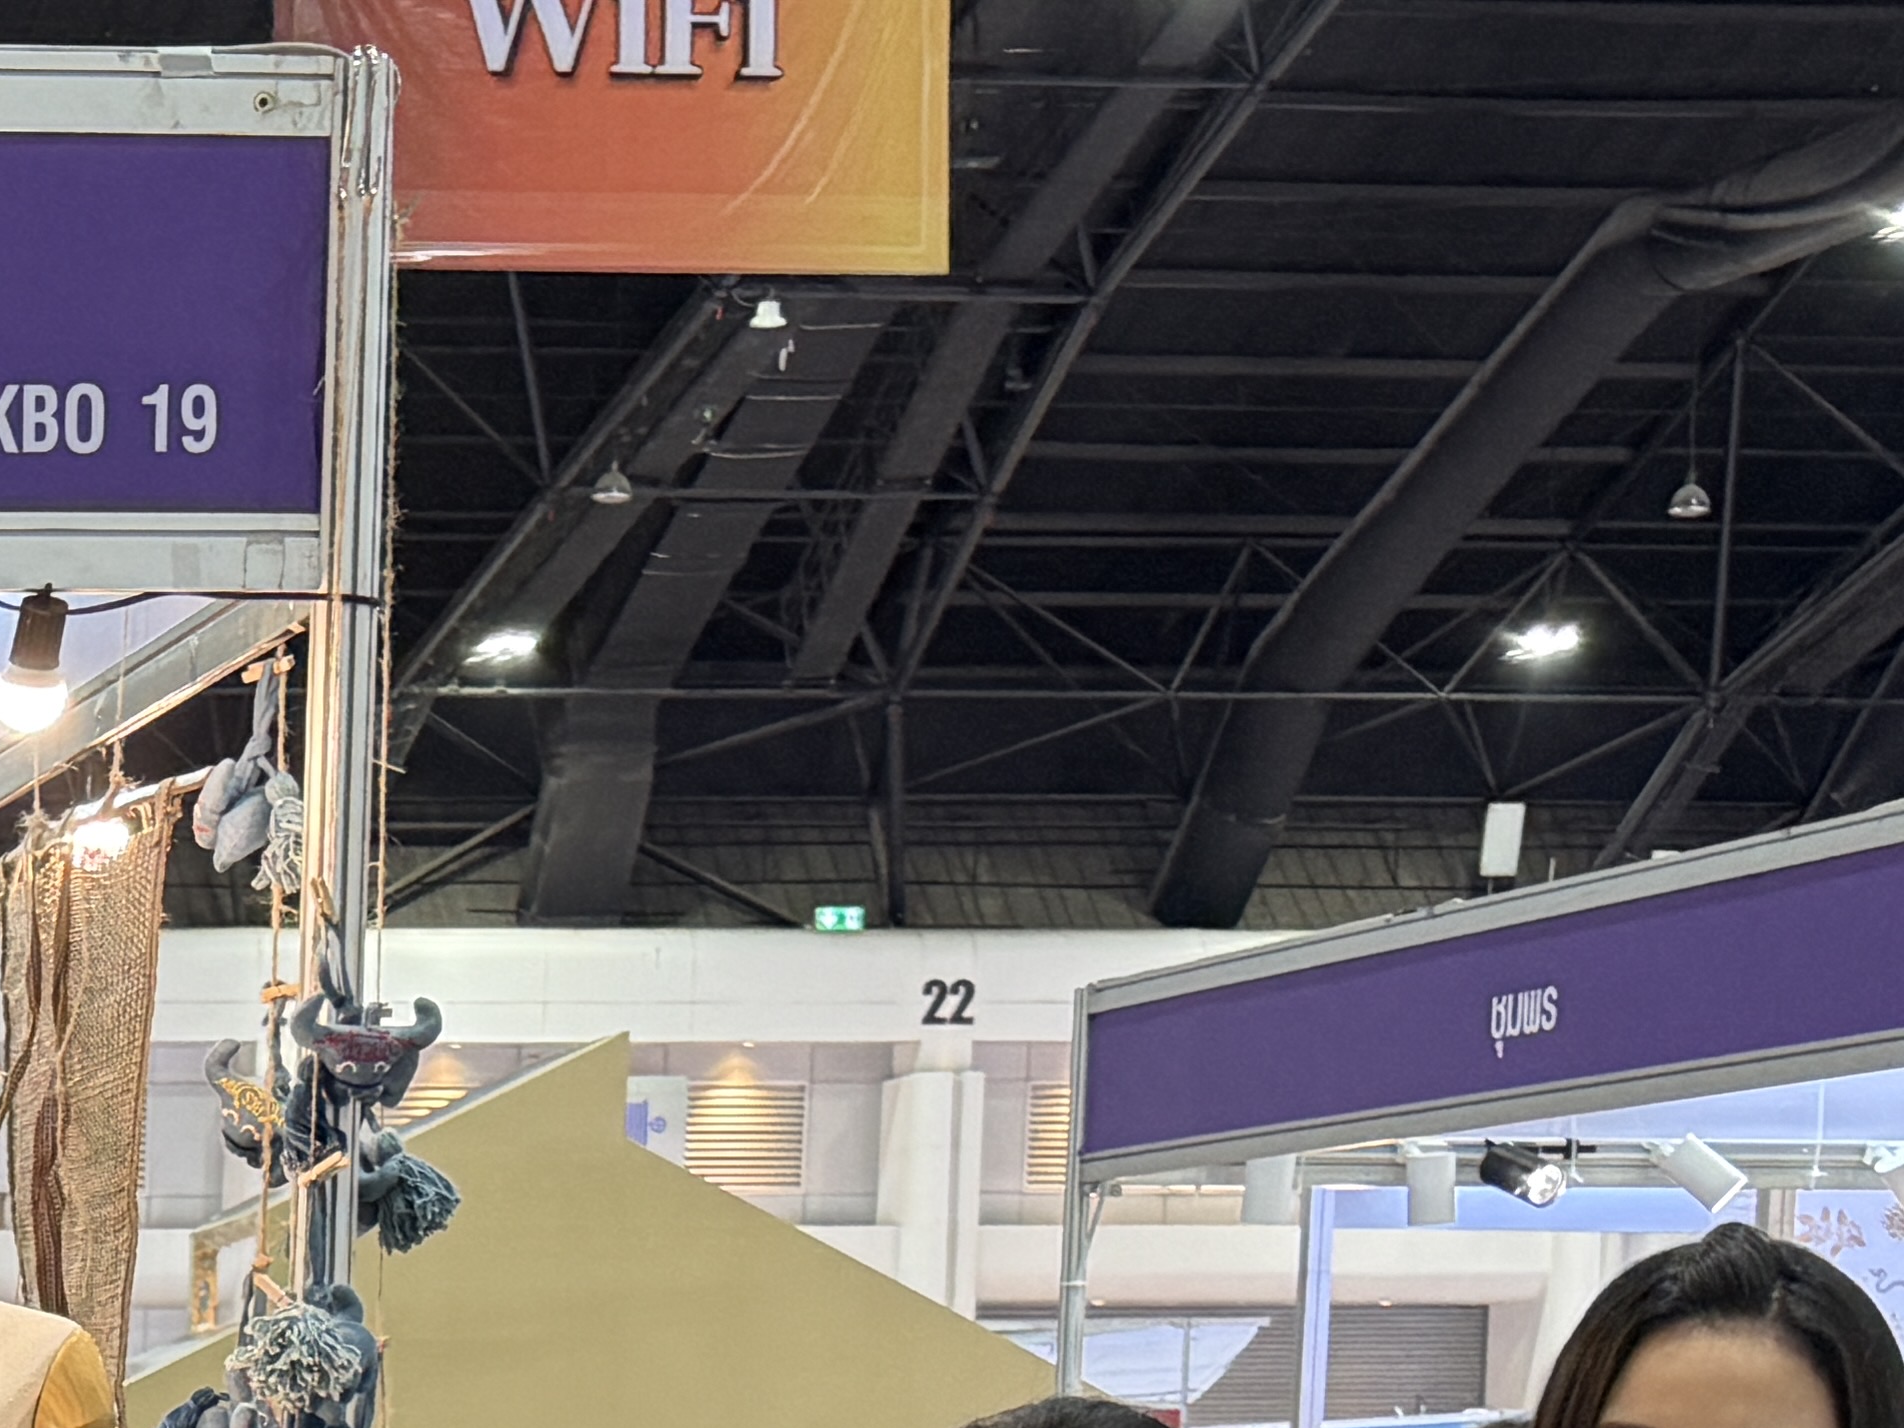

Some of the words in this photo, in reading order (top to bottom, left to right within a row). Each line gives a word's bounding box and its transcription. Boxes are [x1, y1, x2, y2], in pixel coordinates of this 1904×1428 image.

[141, 383, 218, 454] 19
[921, 978, 976, 1025] 22
[1490, 985, 1559, 1059] ชุมพร
